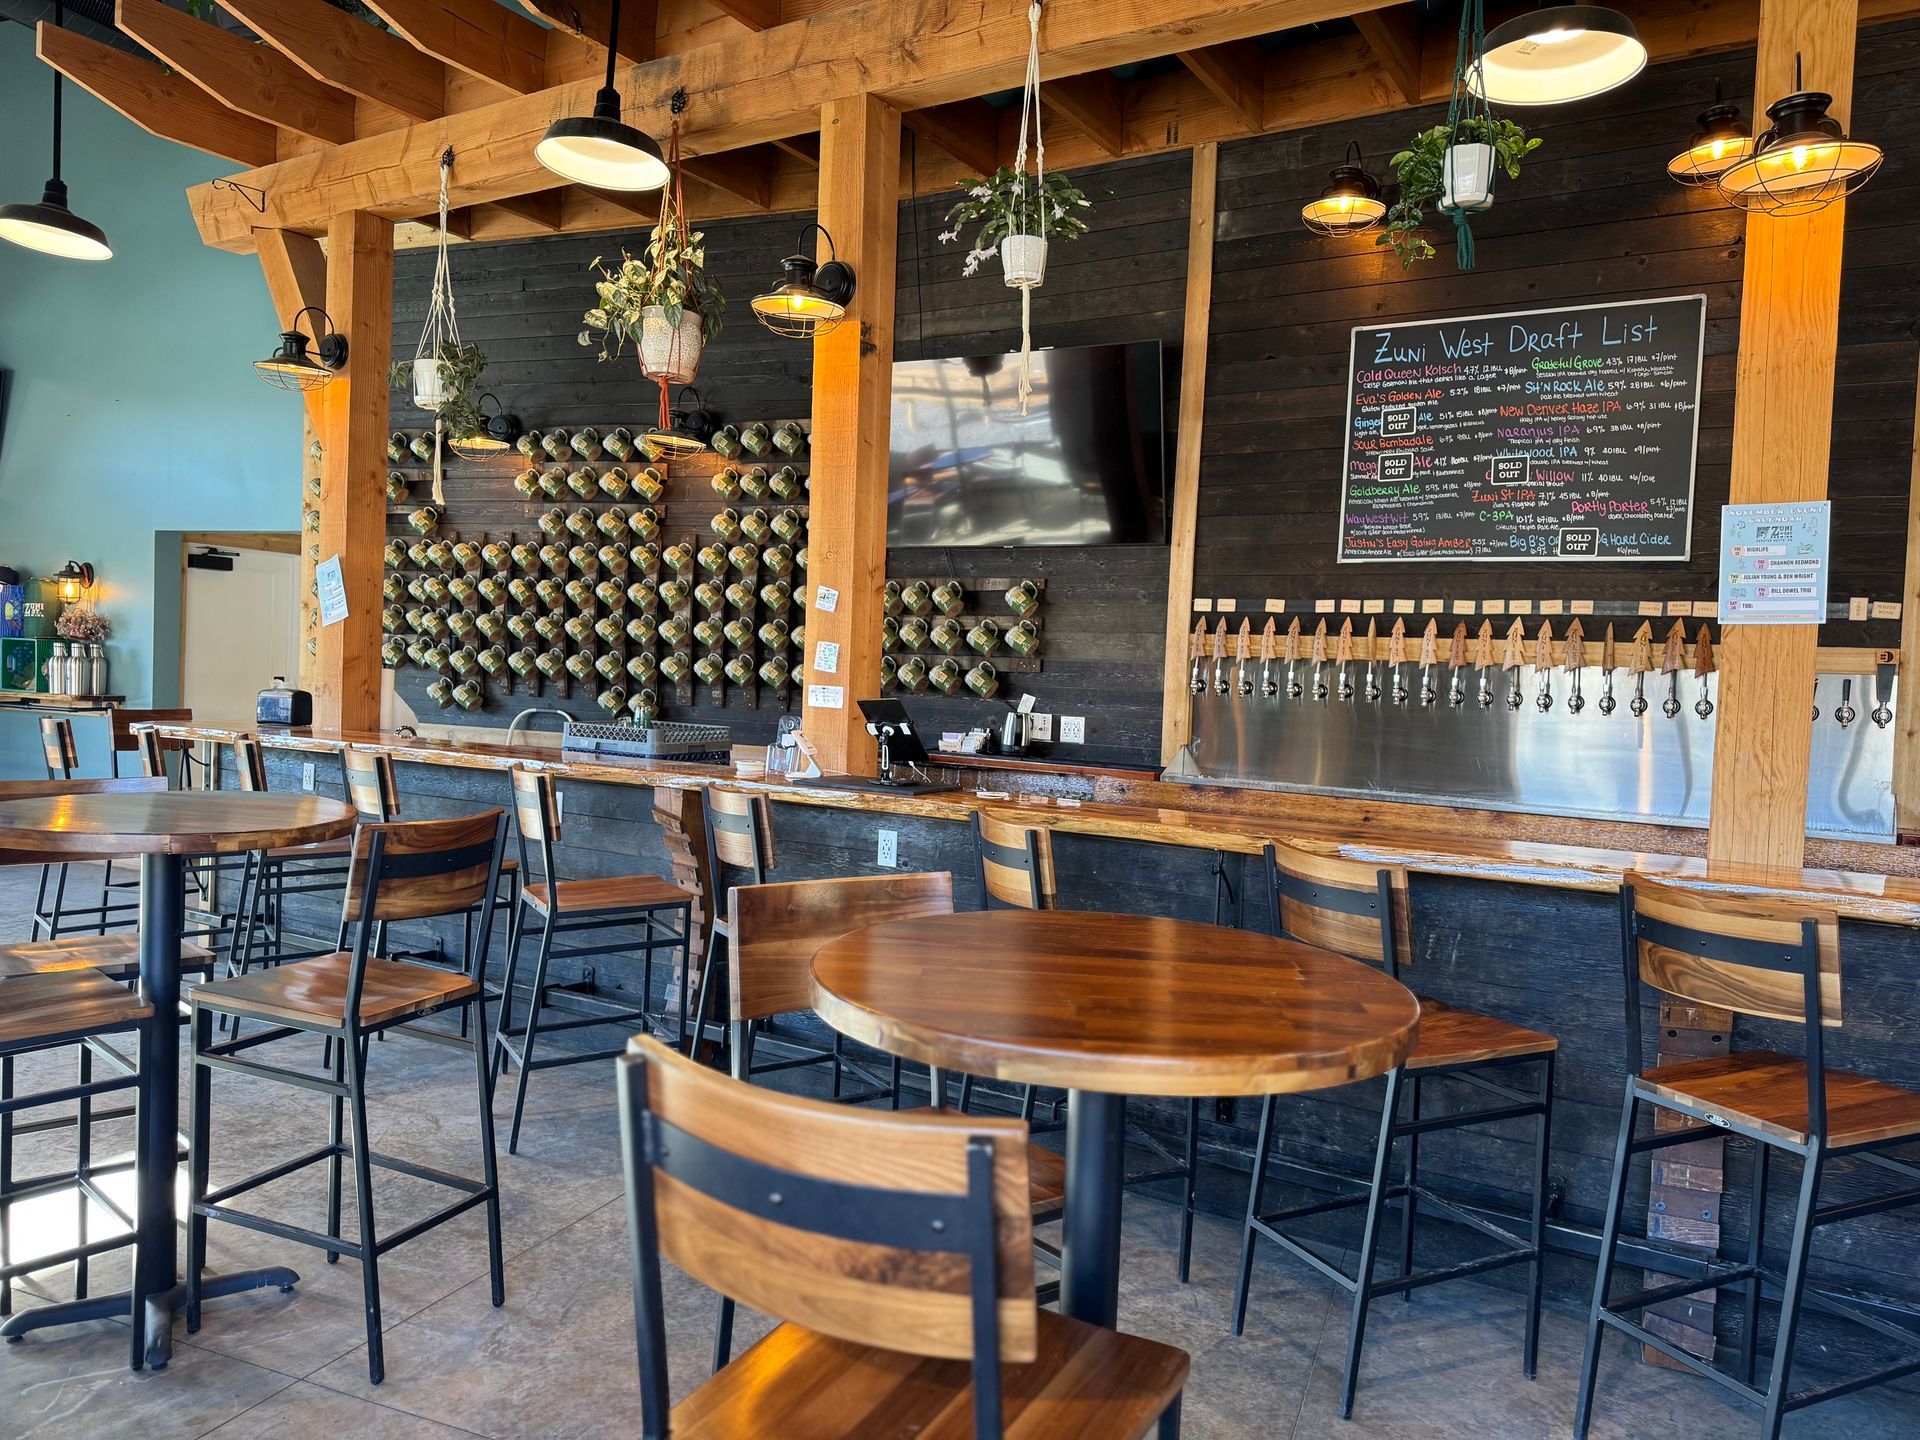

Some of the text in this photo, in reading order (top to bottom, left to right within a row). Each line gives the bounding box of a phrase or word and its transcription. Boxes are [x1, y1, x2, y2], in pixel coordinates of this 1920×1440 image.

[1374, 315, 1657, 363] Zuni West Draft List
[1531, 356, 1573, 371] Grateful
[1573, 355, 1605, 370] Grove
[1356, 370, 1382, 383] Cold
[1425, 363, 1461, 377] Kolsch
[1583, 378, 1605, 392] Ale
[1355, 393, 1387, 405] Eva's
[1424, 388, 1445, 399] Ale
[1499, 405, 1524, 417] New
[1526, 403, 1570, 416] Denver
[1572, 401, 1599, 414] Haze
[1602, 400, 1621, 413] IPA
[1387, 413, 1410, 422] SOLD
[1418, 412, 1433, 422] Ale
[1388, 422, 1408, 430] OUT
[1559, 425, 1580, 436] IPA
[1560, 446, 1578, 457] IPA
[1584, 446, 1596, 456] 9%
[1384, 459, 1407, 467] SOLD
[1414, 456, 1433, 467] Ale
[1498, 461, 1523, 470] SOLD
[1385, 467, 1405, 475] OUT
[1499, 470, 1520, 479] OUT
[1535, 469, 1575, 482] Willow
[1581, 472, 1594, 482] 11%
[1349, 485, 1400, 498] Goldberry
[1402, 483, 1421, 494] Ale
[1471, 489, 1498, 502] Zuni
[1500, 488, 1514, 500] St
[1516, 489, 1536, 500] IPA
[1608, 500, 1649, 513] Porter
[1479, 510, 1515, 521] C-3PA
[1771, 525, 1793, 536] ZUNI
[1344, 536, 1384, 548] Justin's
[1386, 536, 1408, 551] Easy
[1509, 534, 1527, 552] Big
[1610, 532, 1638, 546] Hard
[1639, 532, 1672, 545] Cider
[1565, 534, 1592, 542] SOLD
[1566, 543, 1589, 551] OUT
